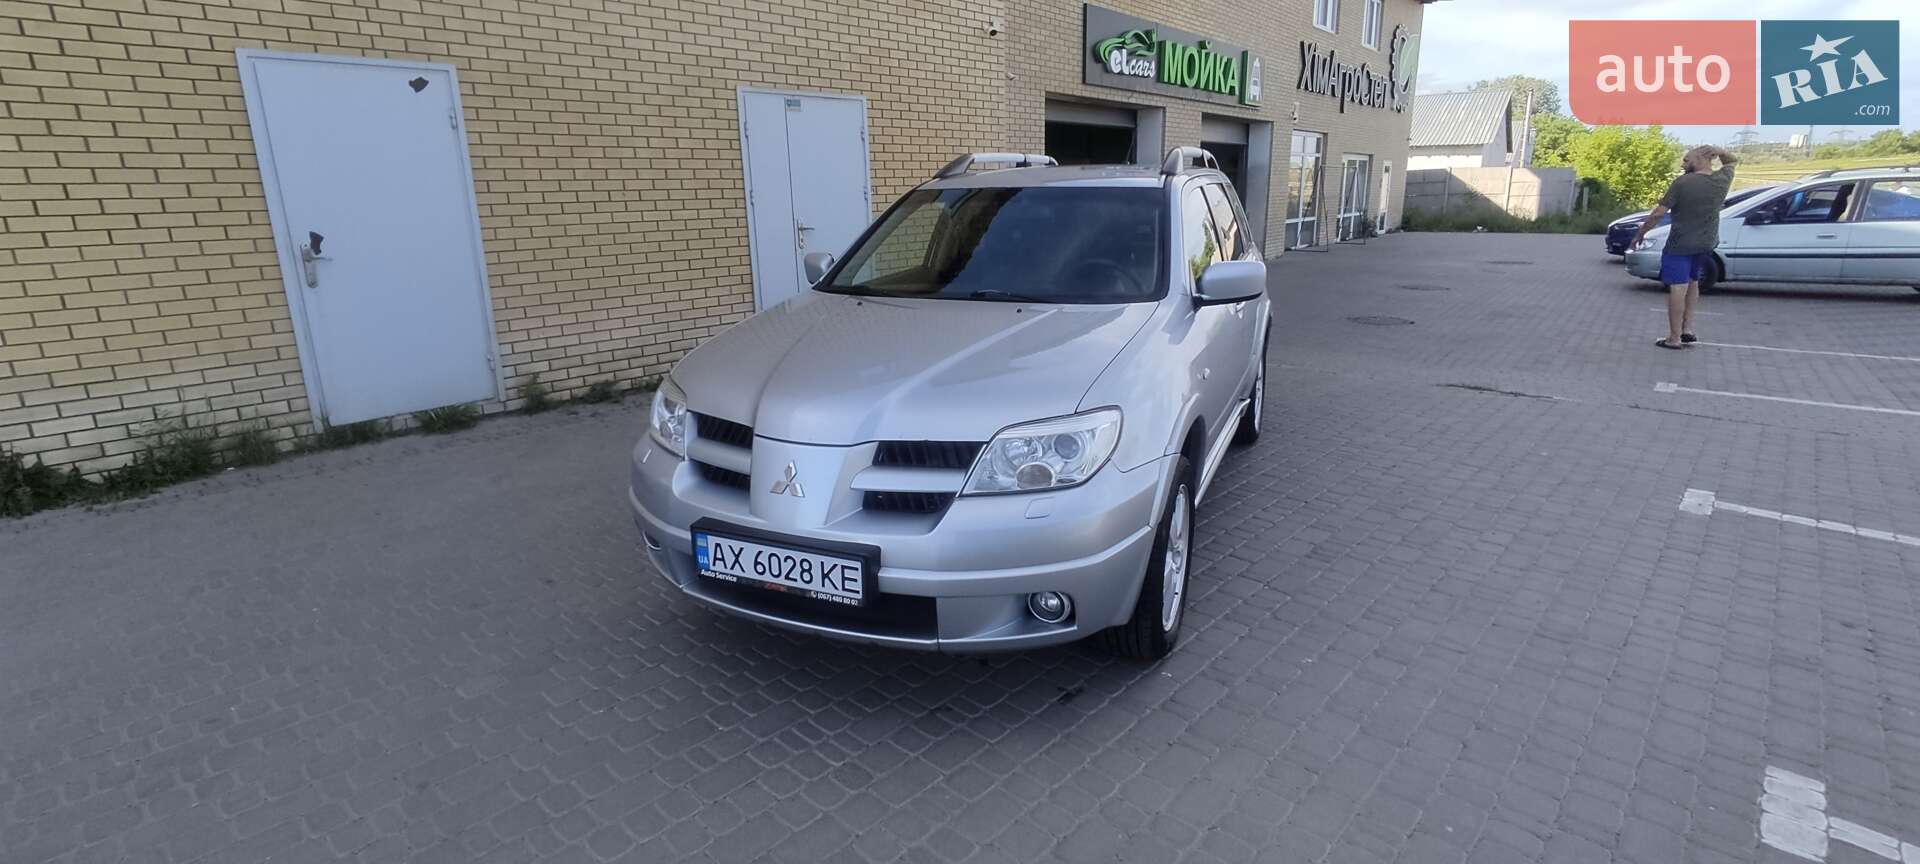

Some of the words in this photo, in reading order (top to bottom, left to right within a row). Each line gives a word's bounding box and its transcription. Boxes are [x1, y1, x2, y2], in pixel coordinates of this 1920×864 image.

[1162, 40, 1239, 96] МОЙКА
[698, 556, 708, 564] UA
[701, 569, 715, 578] Auto
[716, 572, 737, 582] Service
[712, 542, 746, 573] AX
[753, 550, 814, 585] 6028
[820, 560, 860, 595] KE
